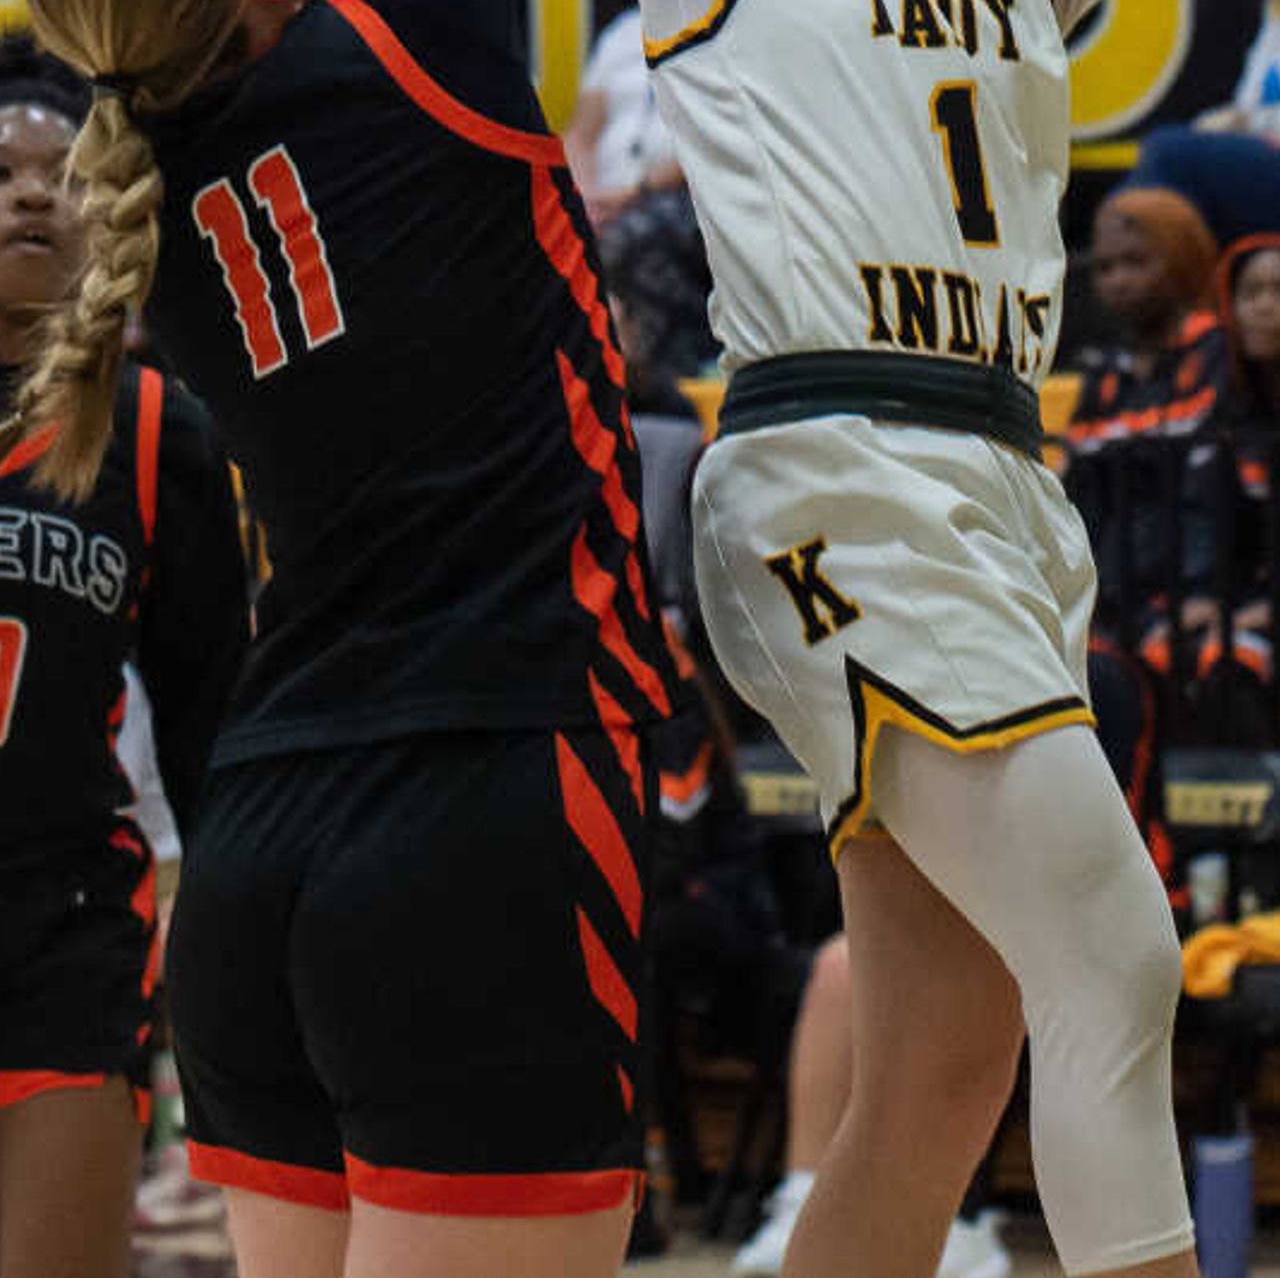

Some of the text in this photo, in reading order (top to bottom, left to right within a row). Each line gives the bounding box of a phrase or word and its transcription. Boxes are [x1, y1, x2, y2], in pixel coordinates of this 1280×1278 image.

[928, 78, 1003, 250] 1
[192, 142, 347, 381] 11
[759, 533, 865, 650] K
